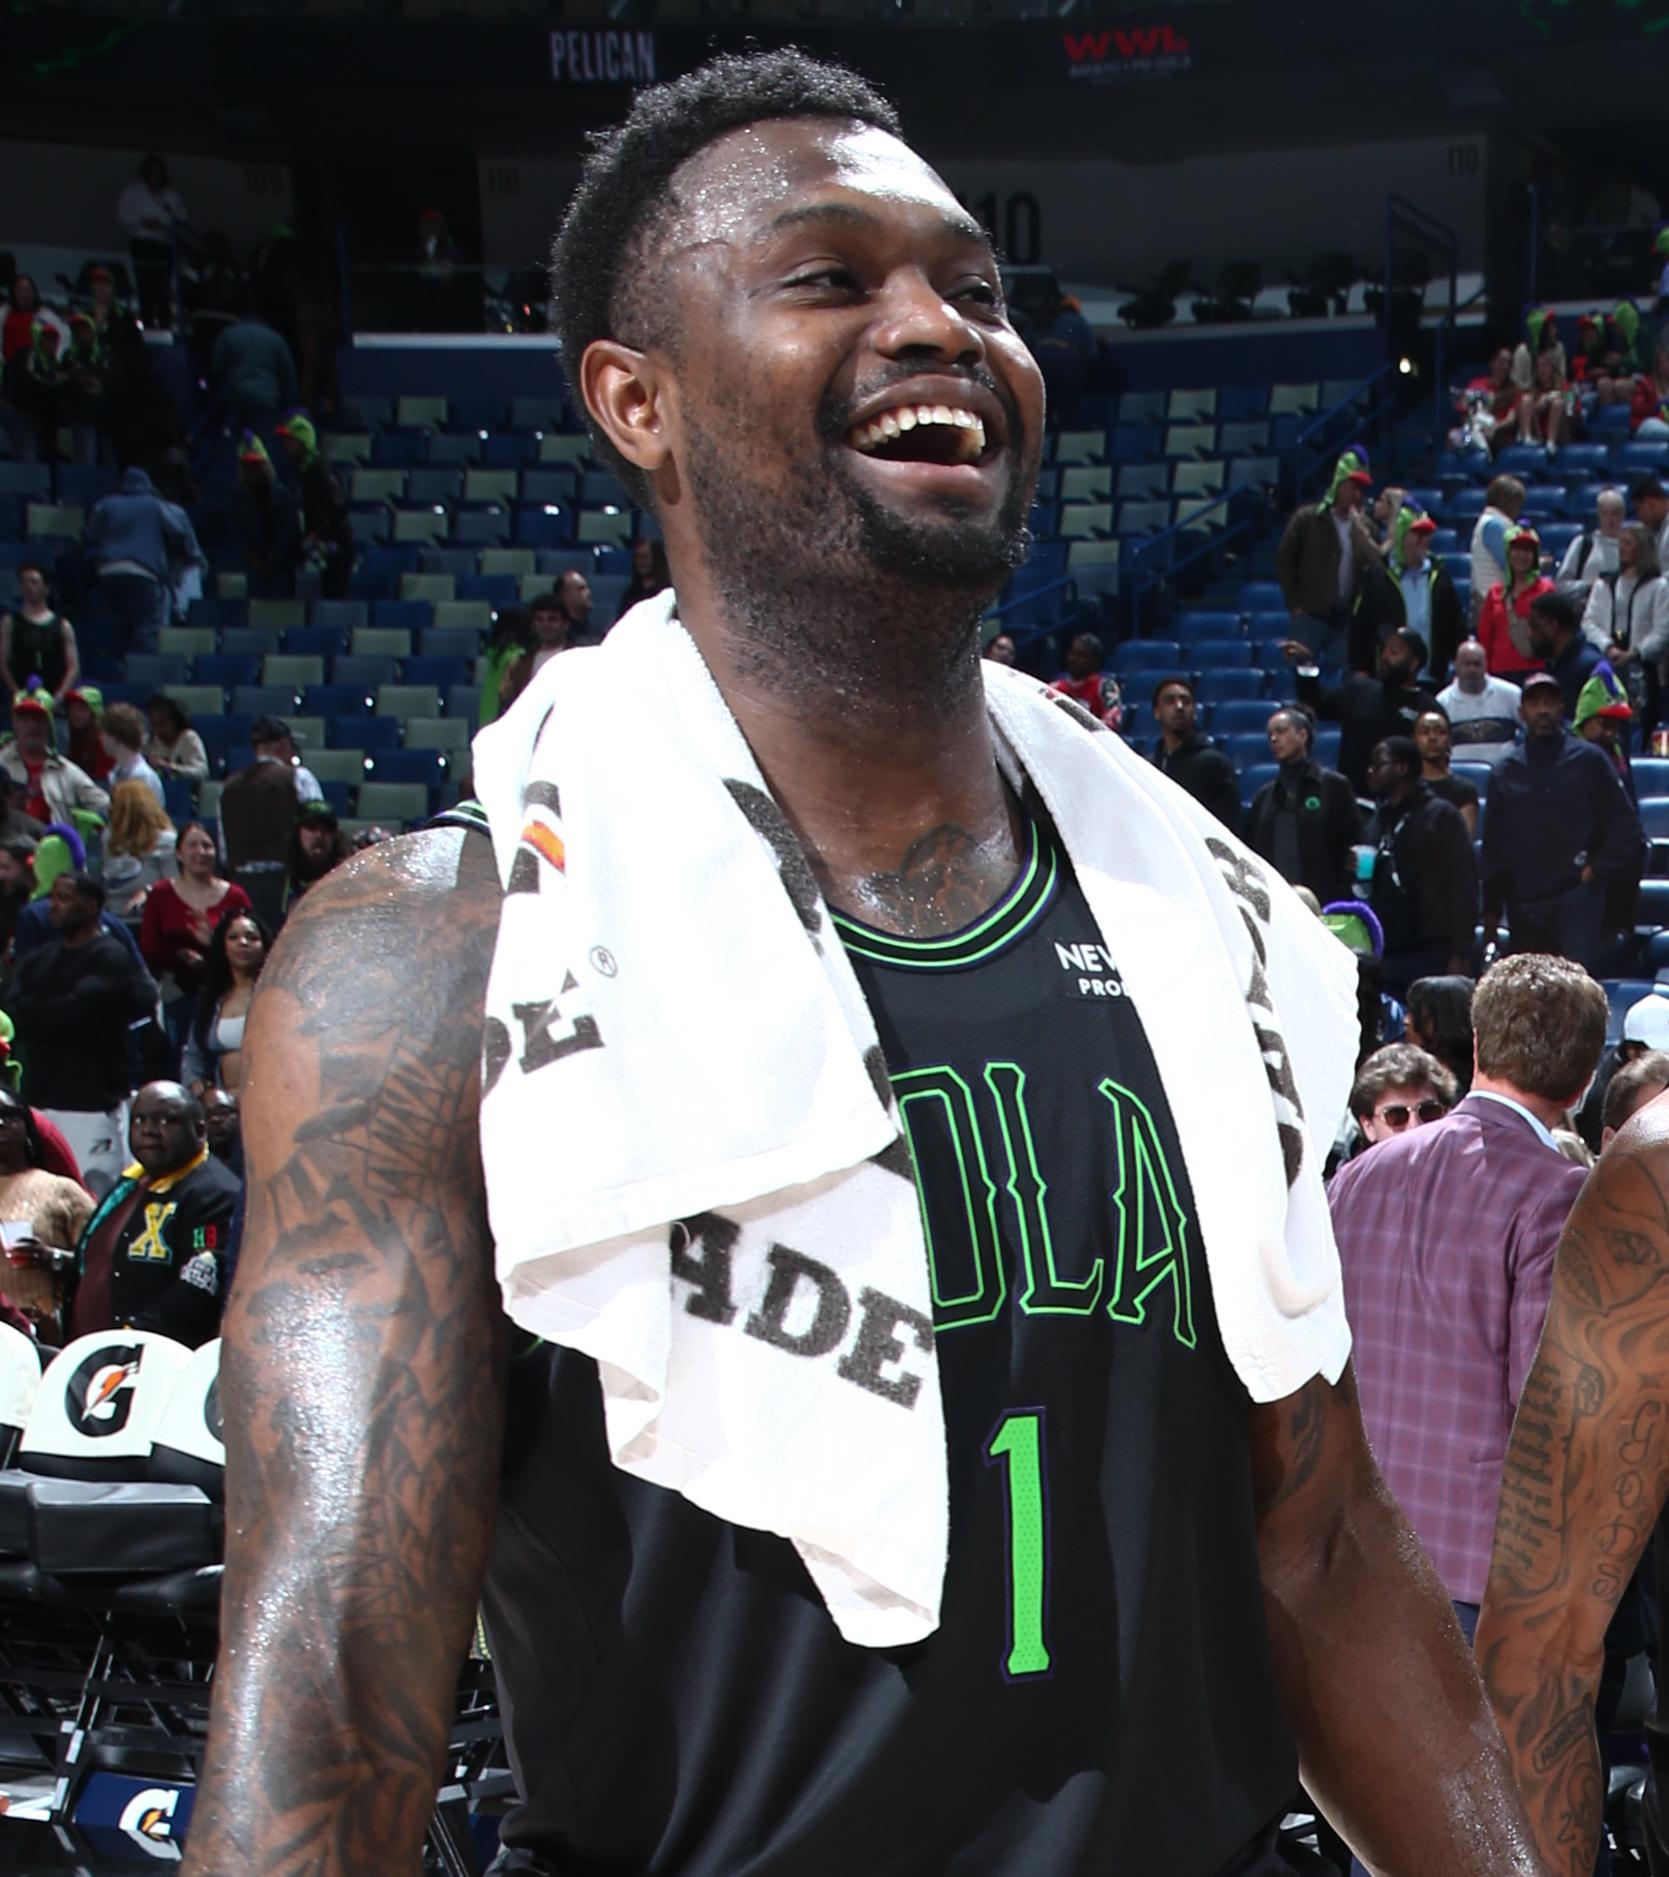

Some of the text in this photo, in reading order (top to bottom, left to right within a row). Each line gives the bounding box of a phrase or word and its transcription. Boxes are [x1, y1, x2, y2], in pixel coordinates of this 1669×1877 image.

[549, 30, 656, 81] PELICAN
[1063, 24, 1190, 63] WWL
[1446, 142, 1479, 175] 110
[958, 190, 1040, 264] 10
[128, 1201, 178, 1264] X
[64, 1343, 146, 1438] G
[983, 1406, 1053, 1683] 1
